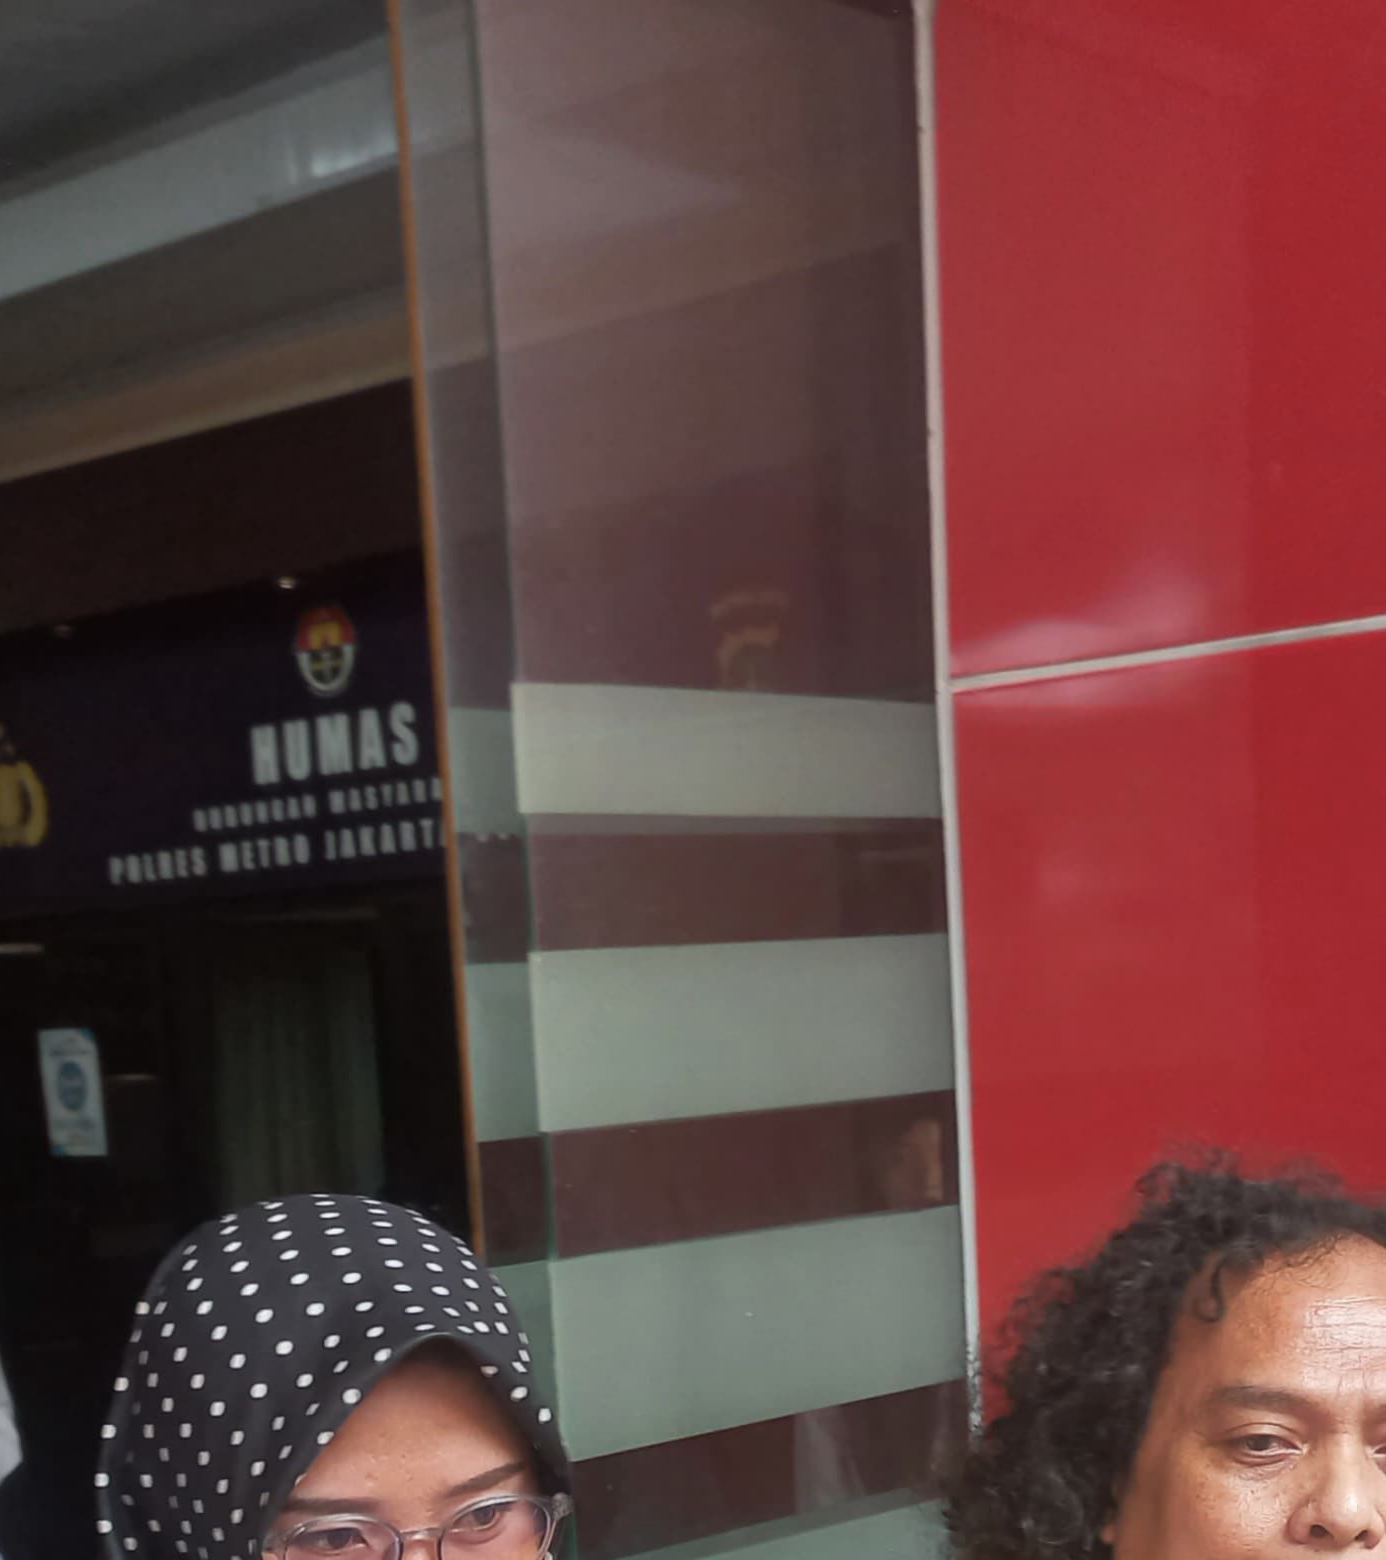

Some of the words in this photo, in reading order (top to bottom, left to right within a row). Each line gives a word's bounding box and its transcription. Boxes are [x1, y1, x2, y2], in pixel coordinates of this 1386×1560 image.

[250, 702, 420, 785] HUMAS
[108, 846, 208, 885] POLRES
[218, 834, 310, 873] METRO
[324, 818, 446, 861] JAKART
